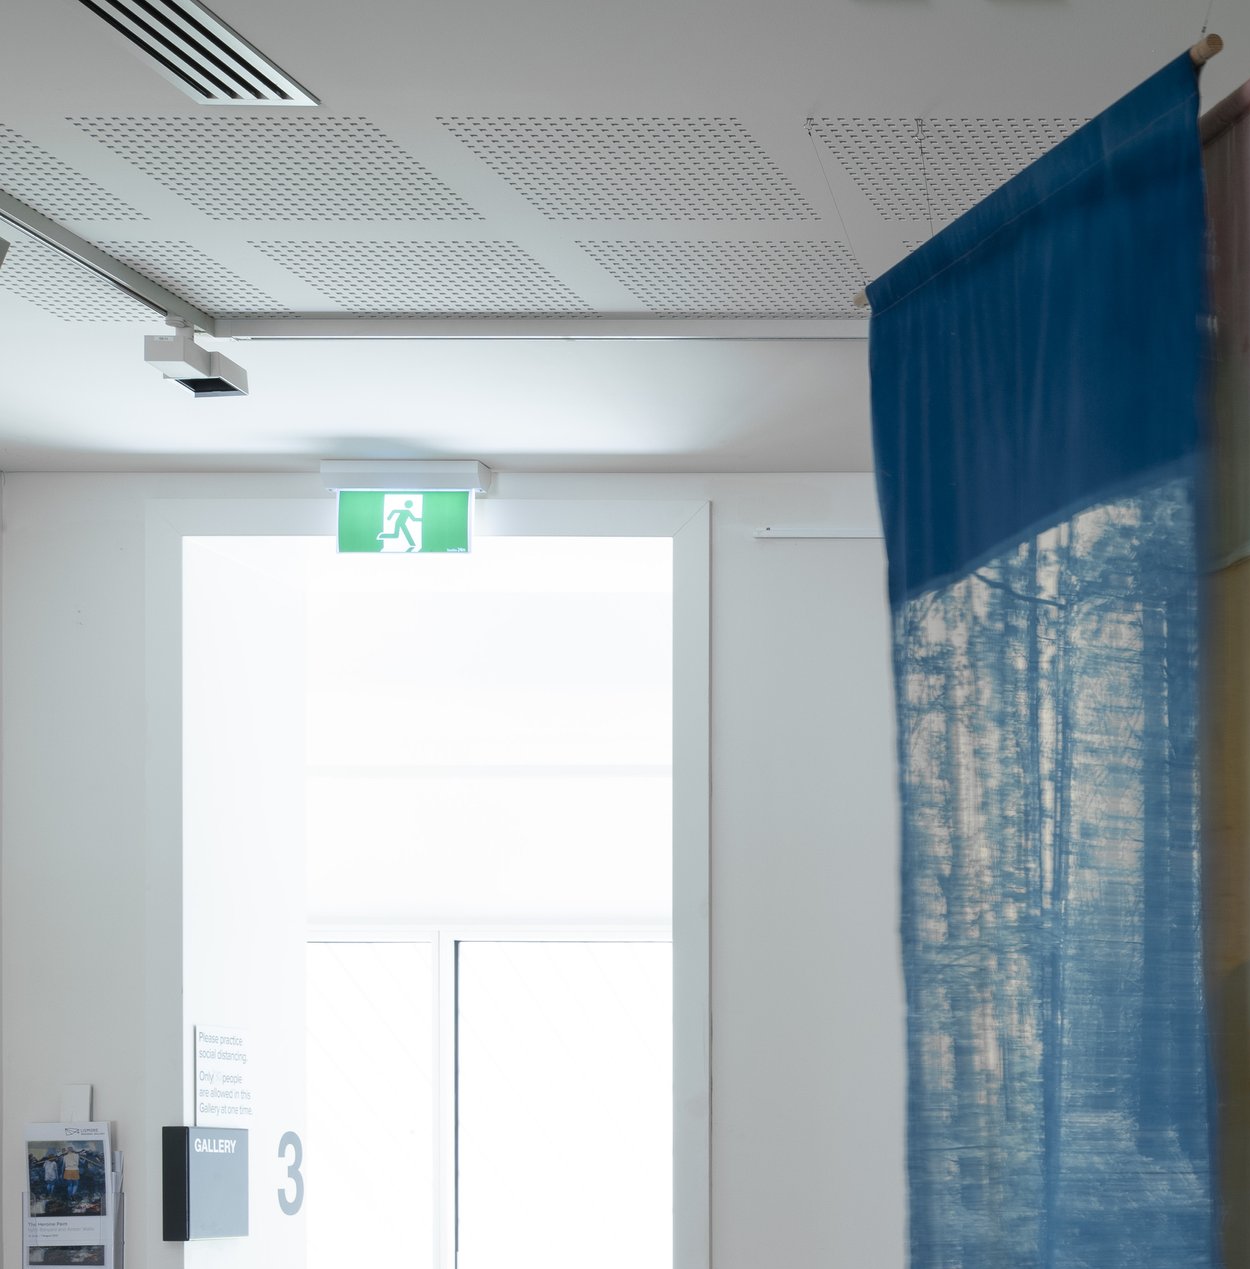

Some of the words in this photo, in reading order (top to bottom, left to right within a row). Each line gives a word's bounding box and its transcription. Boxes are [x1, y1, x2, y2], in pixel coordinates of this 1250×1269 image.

[199, 1031, 219, 1044] Please
[220, 1035, 243, 1047] practice
[199, 1049, 216, 1059] social
[199, 1070, 214, 1084] Only
[223, 1074, 242, 1085] people
[199, 1089, 209, 1098] are
[210, 1087, 233, 1099] allowed
[234, 1089, 240, 1099] in
[241, 1089, 251, 1100] this
[199, 1102, 220, 1116] Gallery
[221, 1105, 227, 1115] at
[228, 1107, 239, 1115] one
[194, 1138, 237, 1153] GALLERY
[277, 1131, 304, 1216] 3
